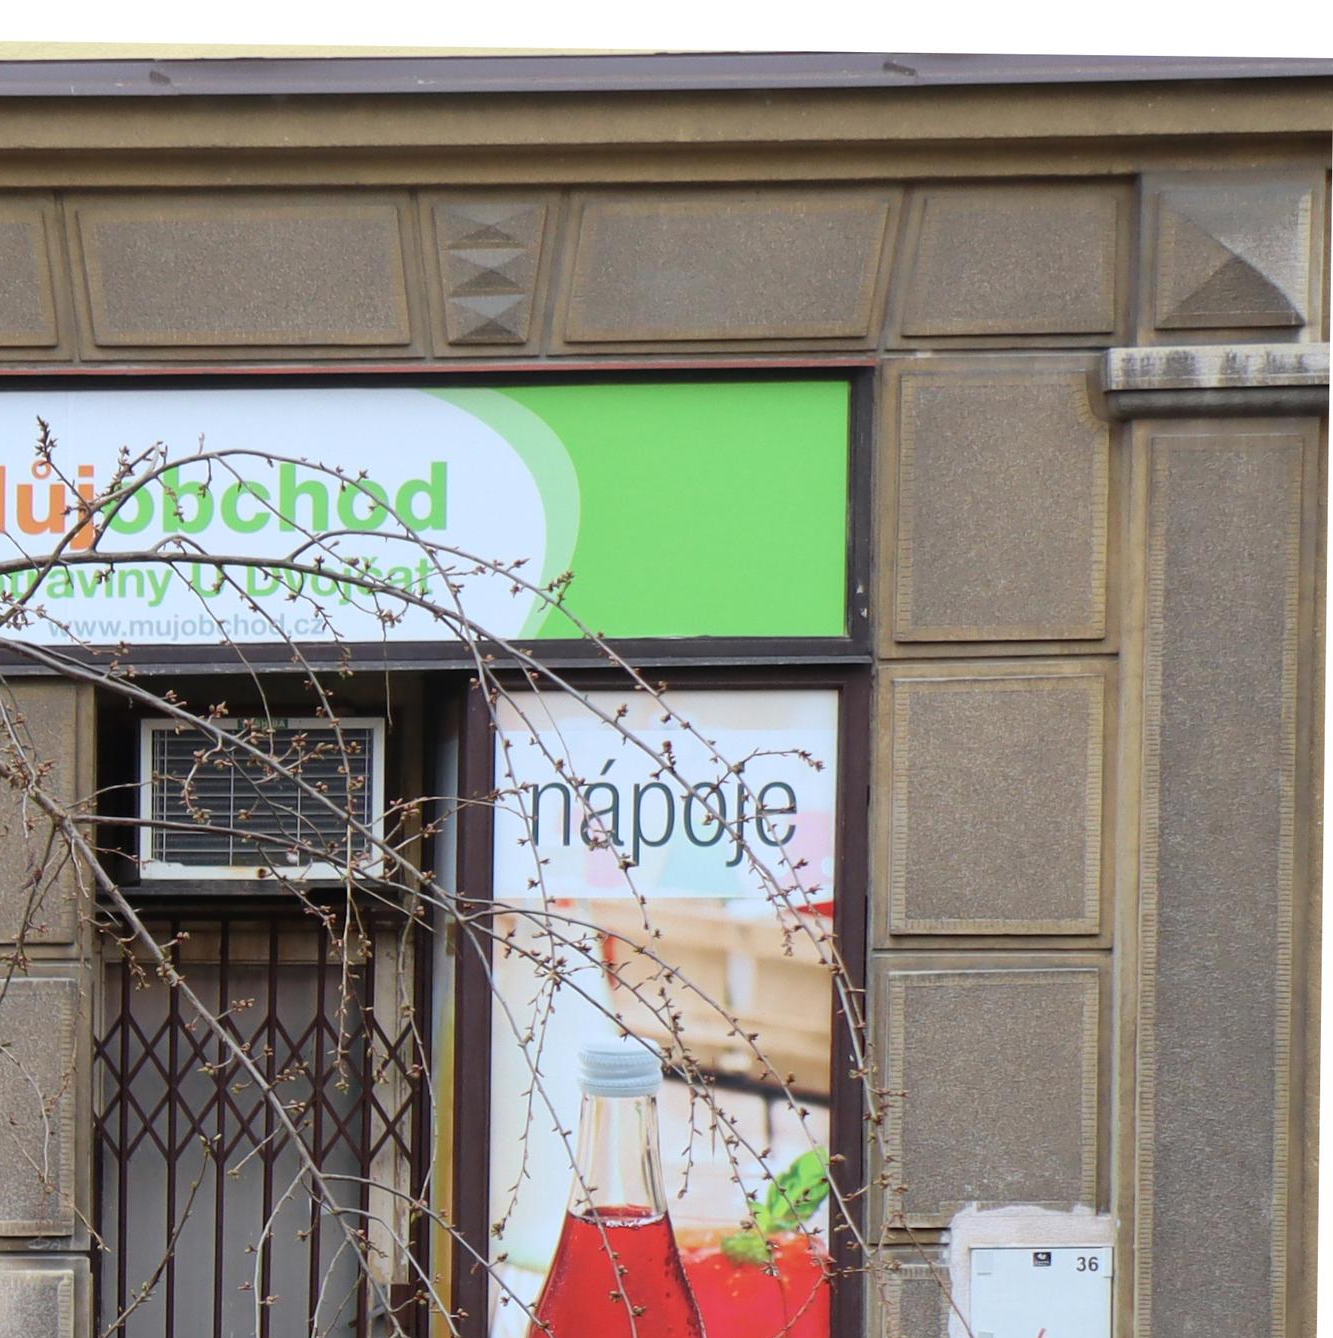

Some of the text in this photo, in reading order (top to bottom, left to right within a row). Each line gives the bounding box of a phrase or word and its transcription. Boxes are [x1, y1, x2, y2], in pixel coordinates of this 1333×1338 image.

[48, 612, 326, 642] www.mujobchod.cz
[530, 758, 798, 869] nápoje
[1076, 1256, 1099, 1272] 36
